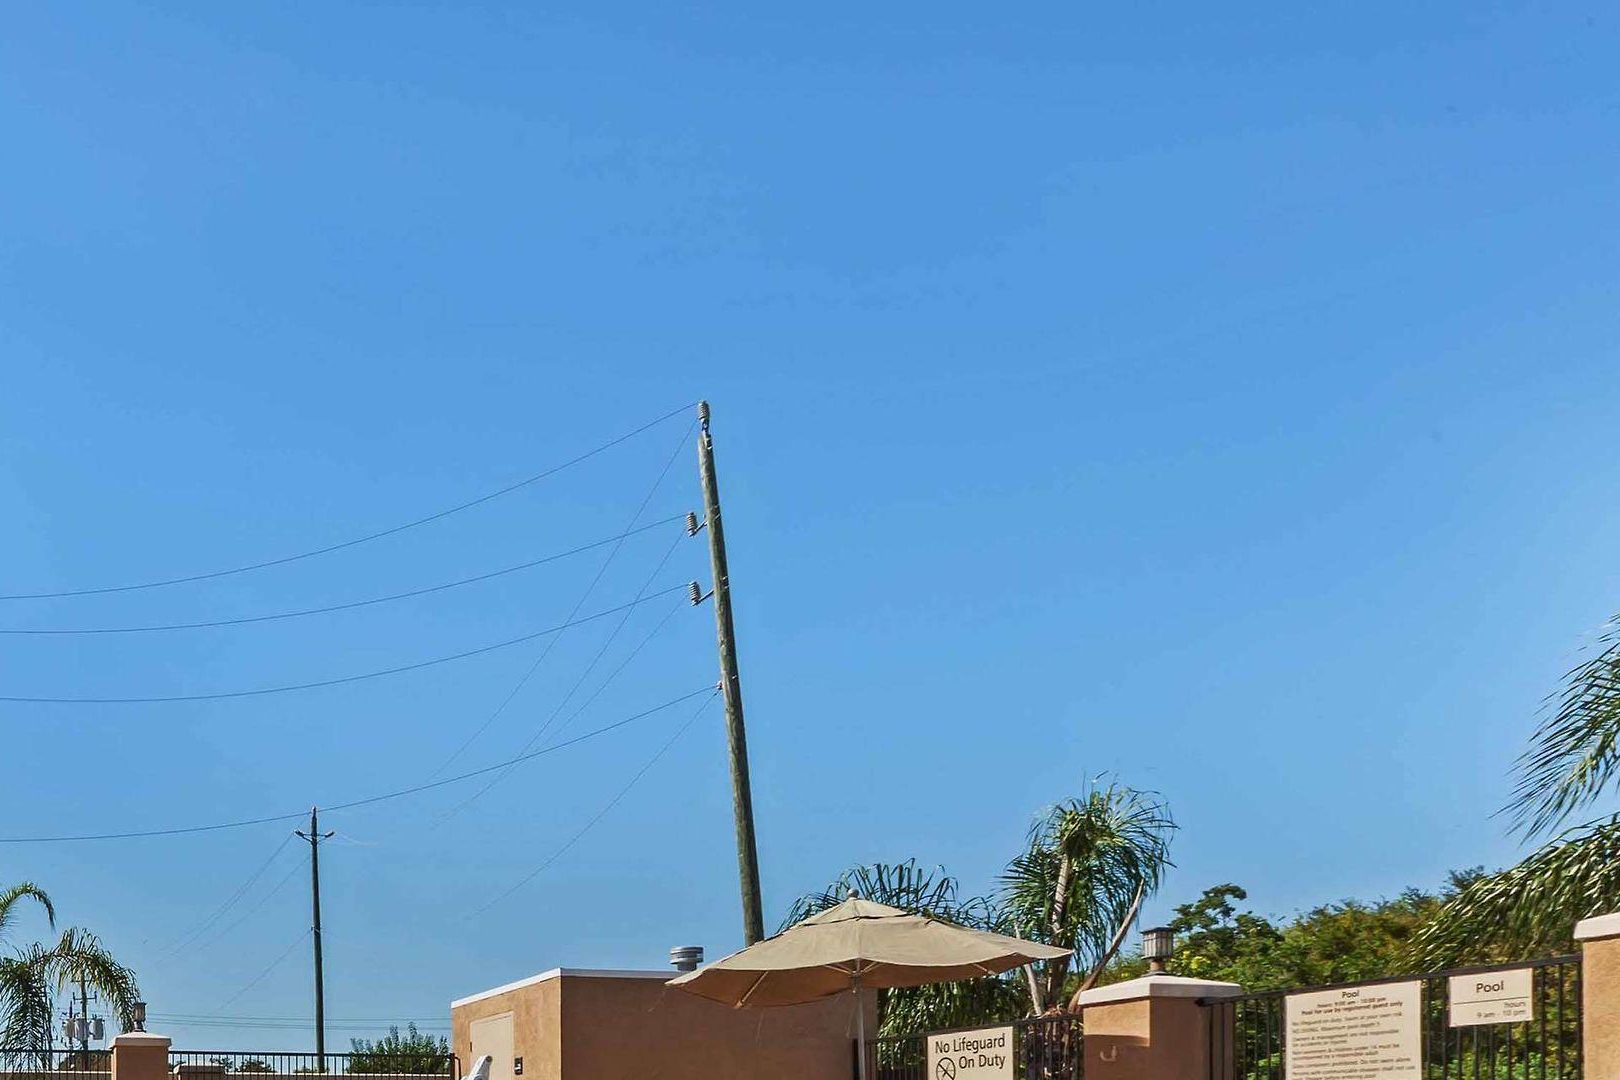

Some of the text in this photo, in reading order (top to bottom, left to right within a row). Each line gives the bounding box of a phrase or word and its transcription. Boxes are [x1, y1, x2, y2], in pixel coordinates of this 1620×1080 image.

[1475, 980, 1504, 993] Pool
[1341, 990, 1360, 999] Pool
[935, 1033, 1005, 1054] No Lifeguard
[958, 1054, 1006, 1069] On Duty
